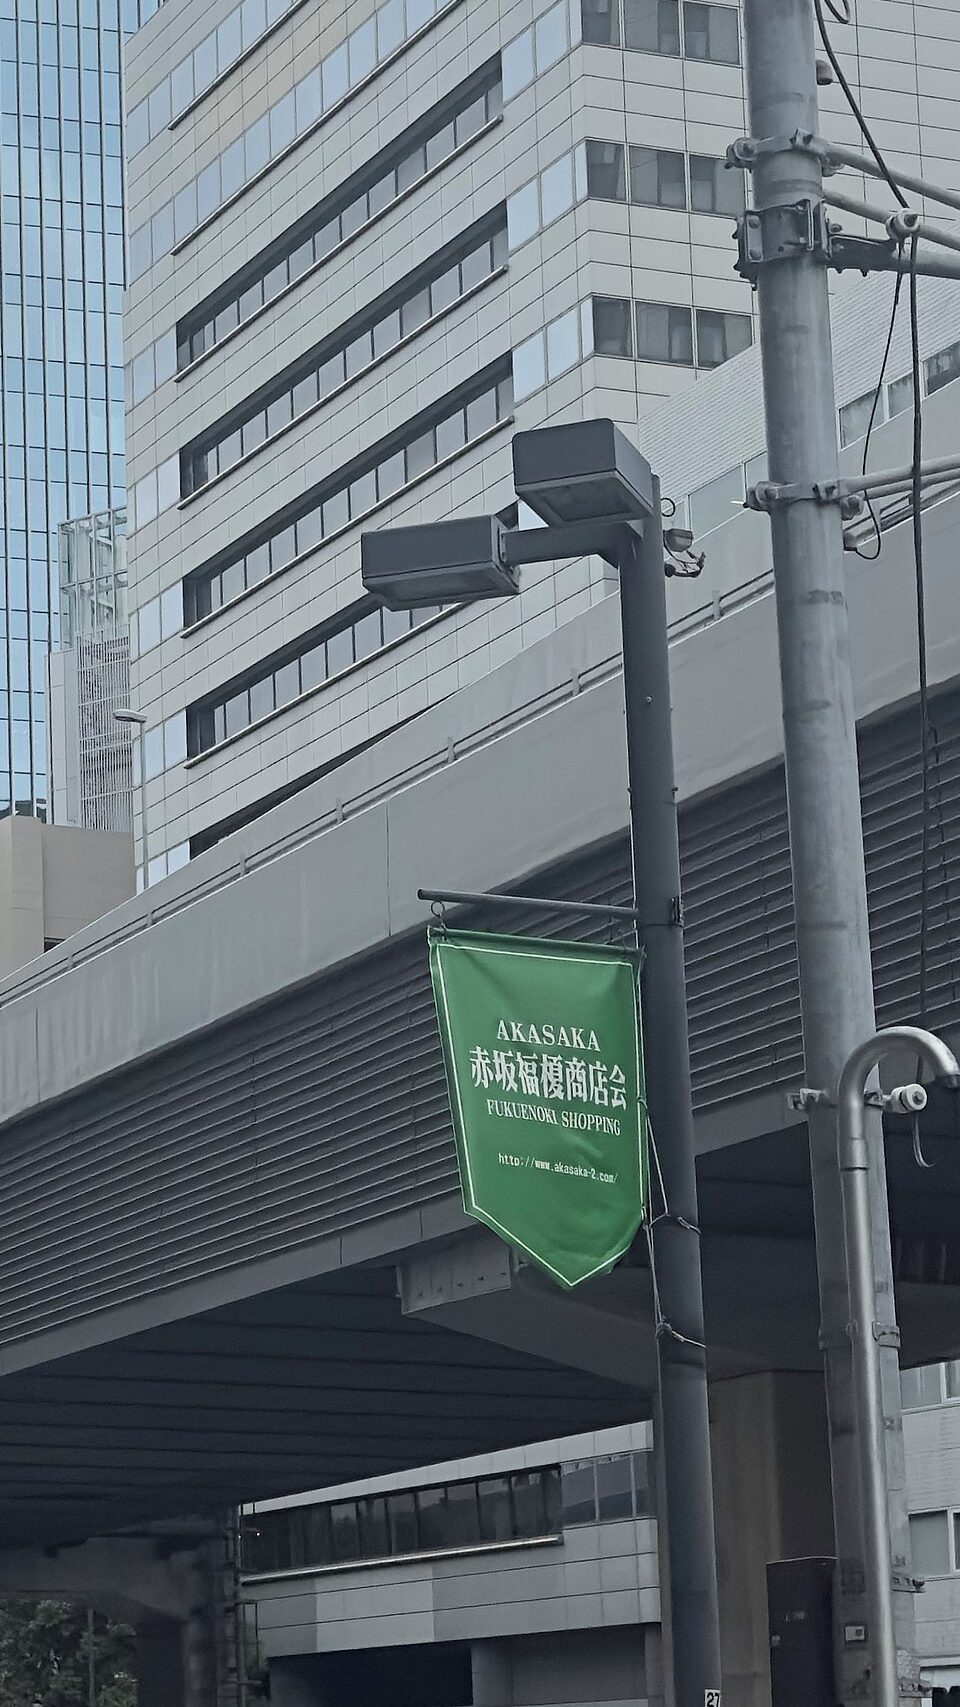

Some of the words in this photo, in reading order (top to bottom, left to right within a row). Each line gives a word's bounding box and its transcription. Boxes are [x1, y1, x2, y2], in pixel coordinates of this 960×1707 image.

[496, 1019, 601, 1052] AKASAKA
[469, 1045, 628, 1111] 赤坂福榎商店会
[486, 1099, 559, 1126] FUKUENOKI
[561, 1110, 621, 1137] SHOPPING
[498, 1152, 619, 1184] http://www.akasaka-2.com/
